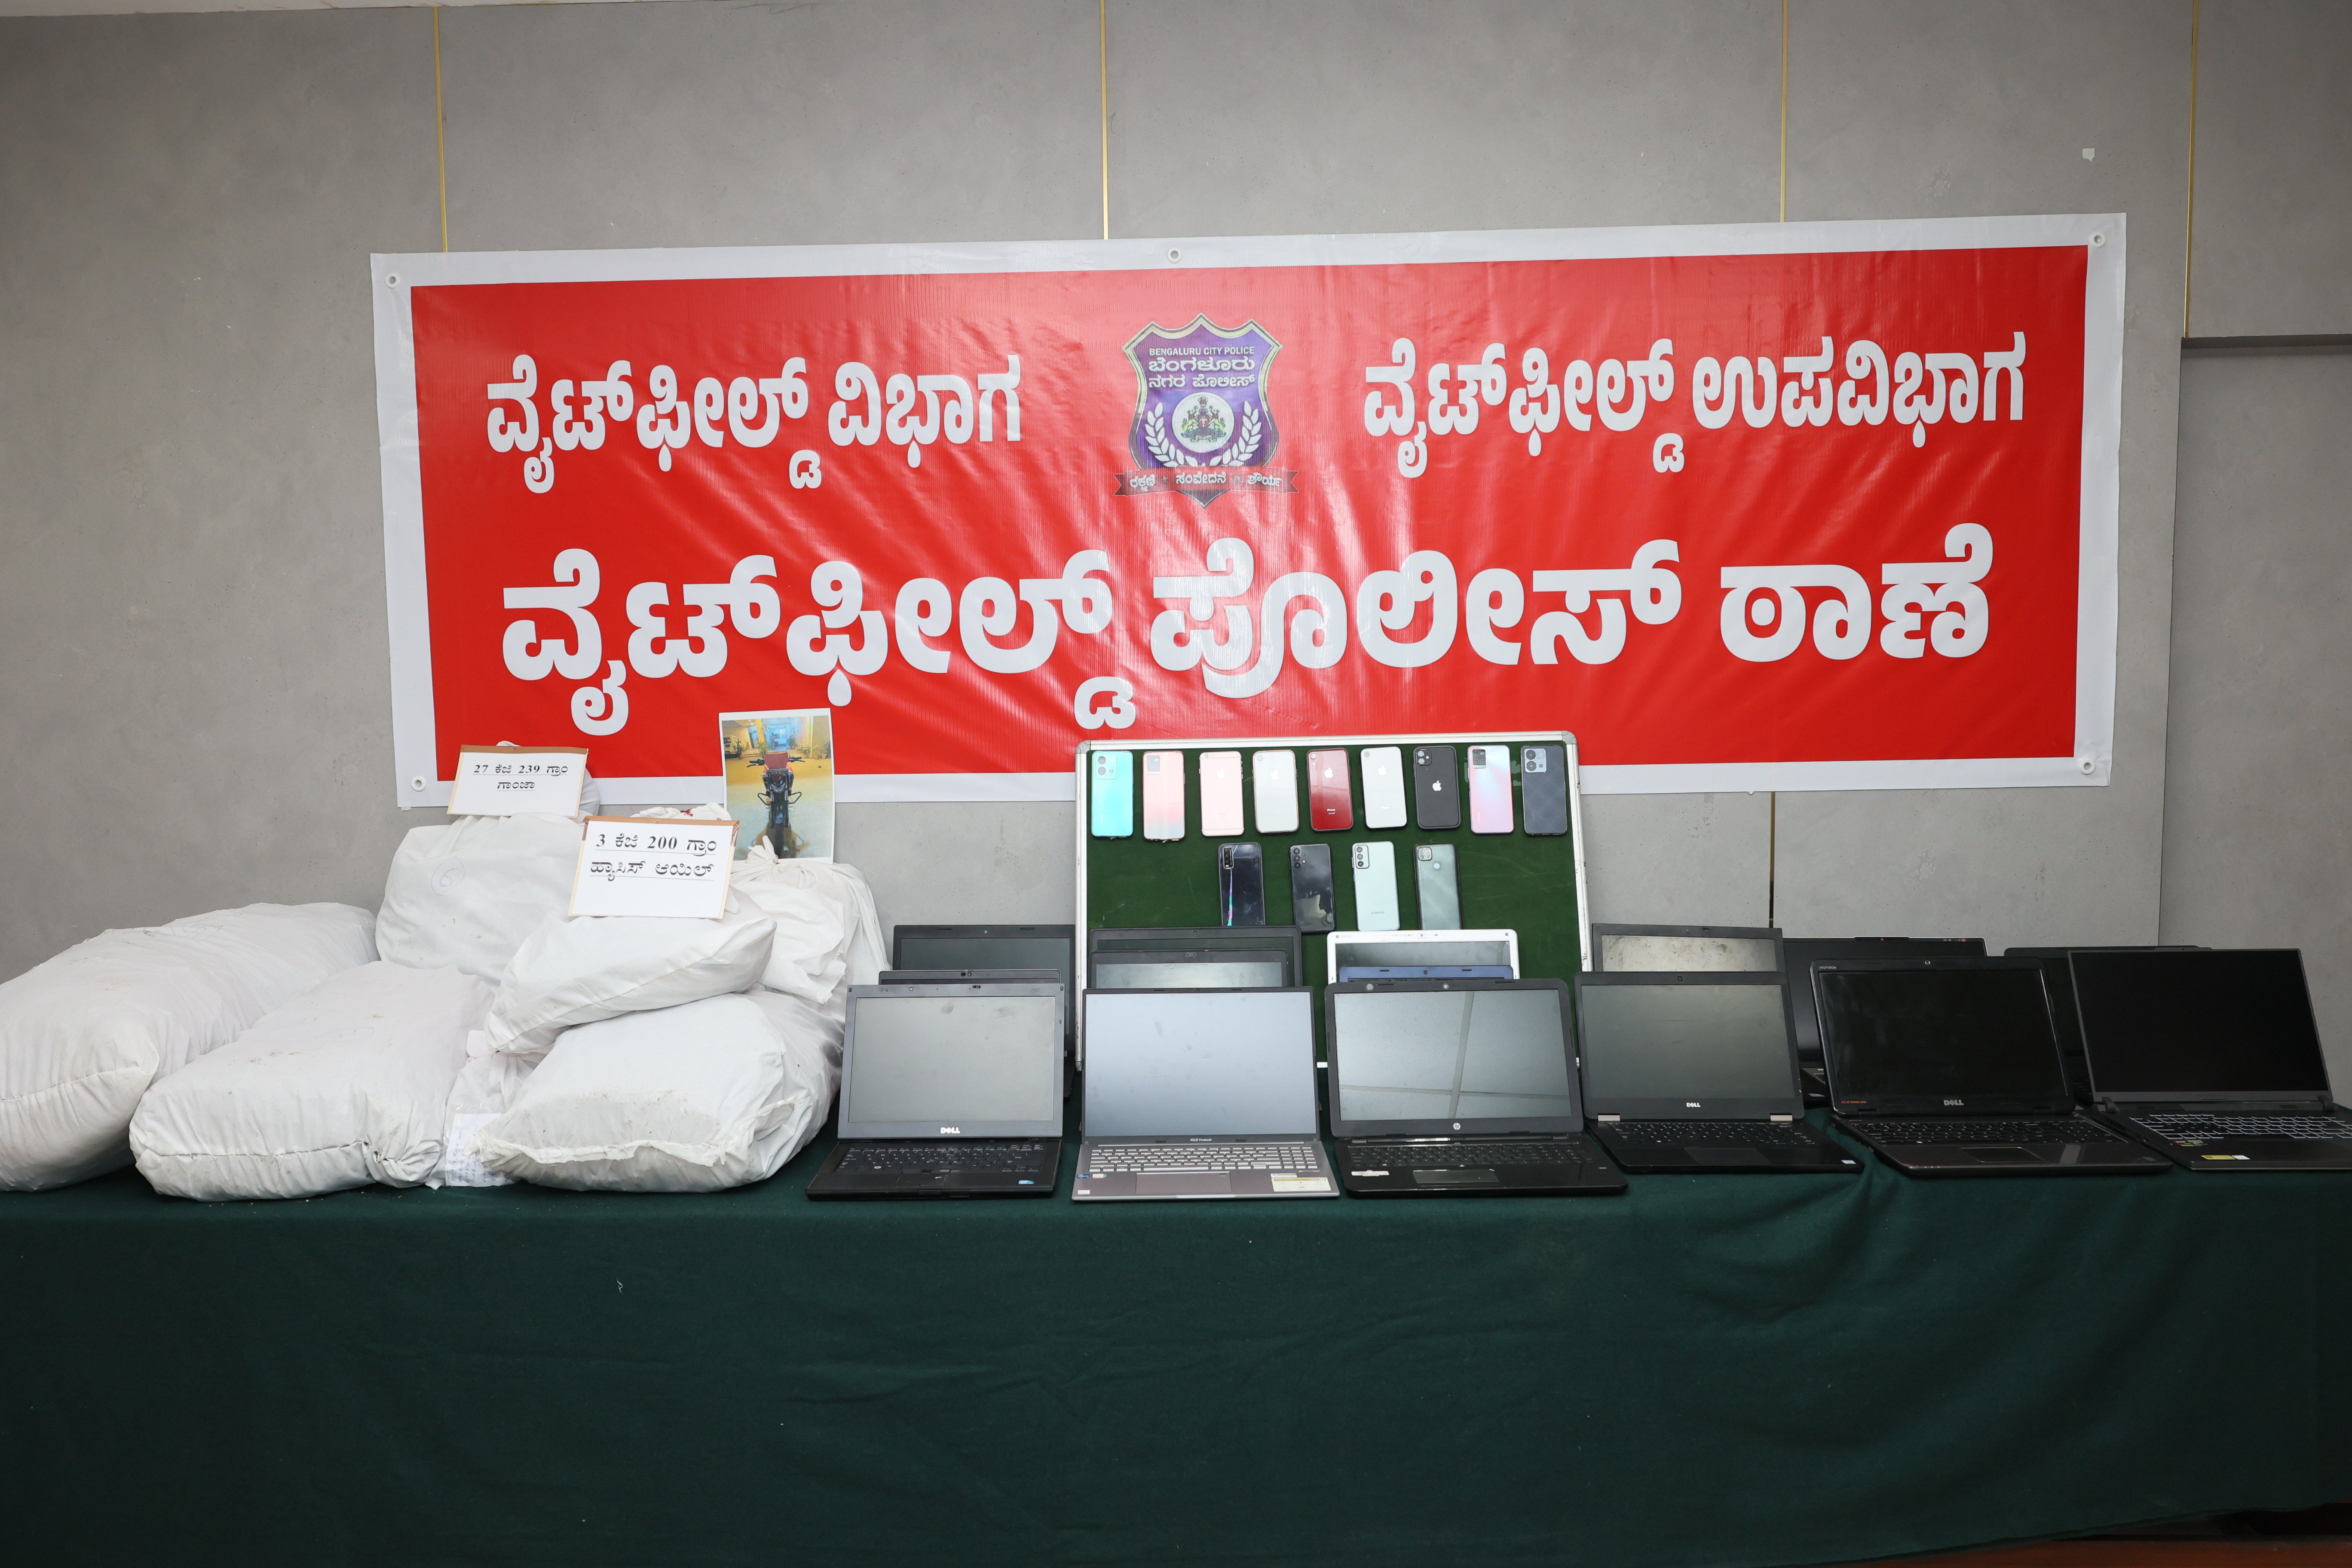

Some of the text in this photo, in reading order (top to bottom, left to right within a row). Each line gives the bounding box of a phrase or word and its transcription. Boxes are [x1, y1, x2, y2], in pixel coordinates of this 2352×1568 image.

[1149, 346, 1255, 356] BENGALURU CITY POLICE
[1148, 356, 1255, 372] ಬೆಂಗಳೂರು
[1148, 374, 1255, 388] ನಗರ ಪೊಲೀಸ್
[1692, 331, 2026, 447] ಉಪವಿಭಾಗ
[828, 354, 1021, 468] ವಿಭಾಗ
[1176, 471, 1227, 484] ಸಂವೇದನೆ
[1150, 537, 1682, 698] ಪೊಲೀಸ್
[1721, 523, 1993, 662] ಠಾಣೆ
[474, 764, 568, 776] 27 ಕೆಜಿ 239 ಗ್ರಾಂ
[497, 780, 535, 789] ಗಾಂಜಾ
[596, 833, 717, 856] 3 ಕೆಜಿ 200 ಗ್ರಾಂ
[590, 861, 714, 881] ಹ್ಯಾಸಿಸ್ ಆಯಿಲ್
